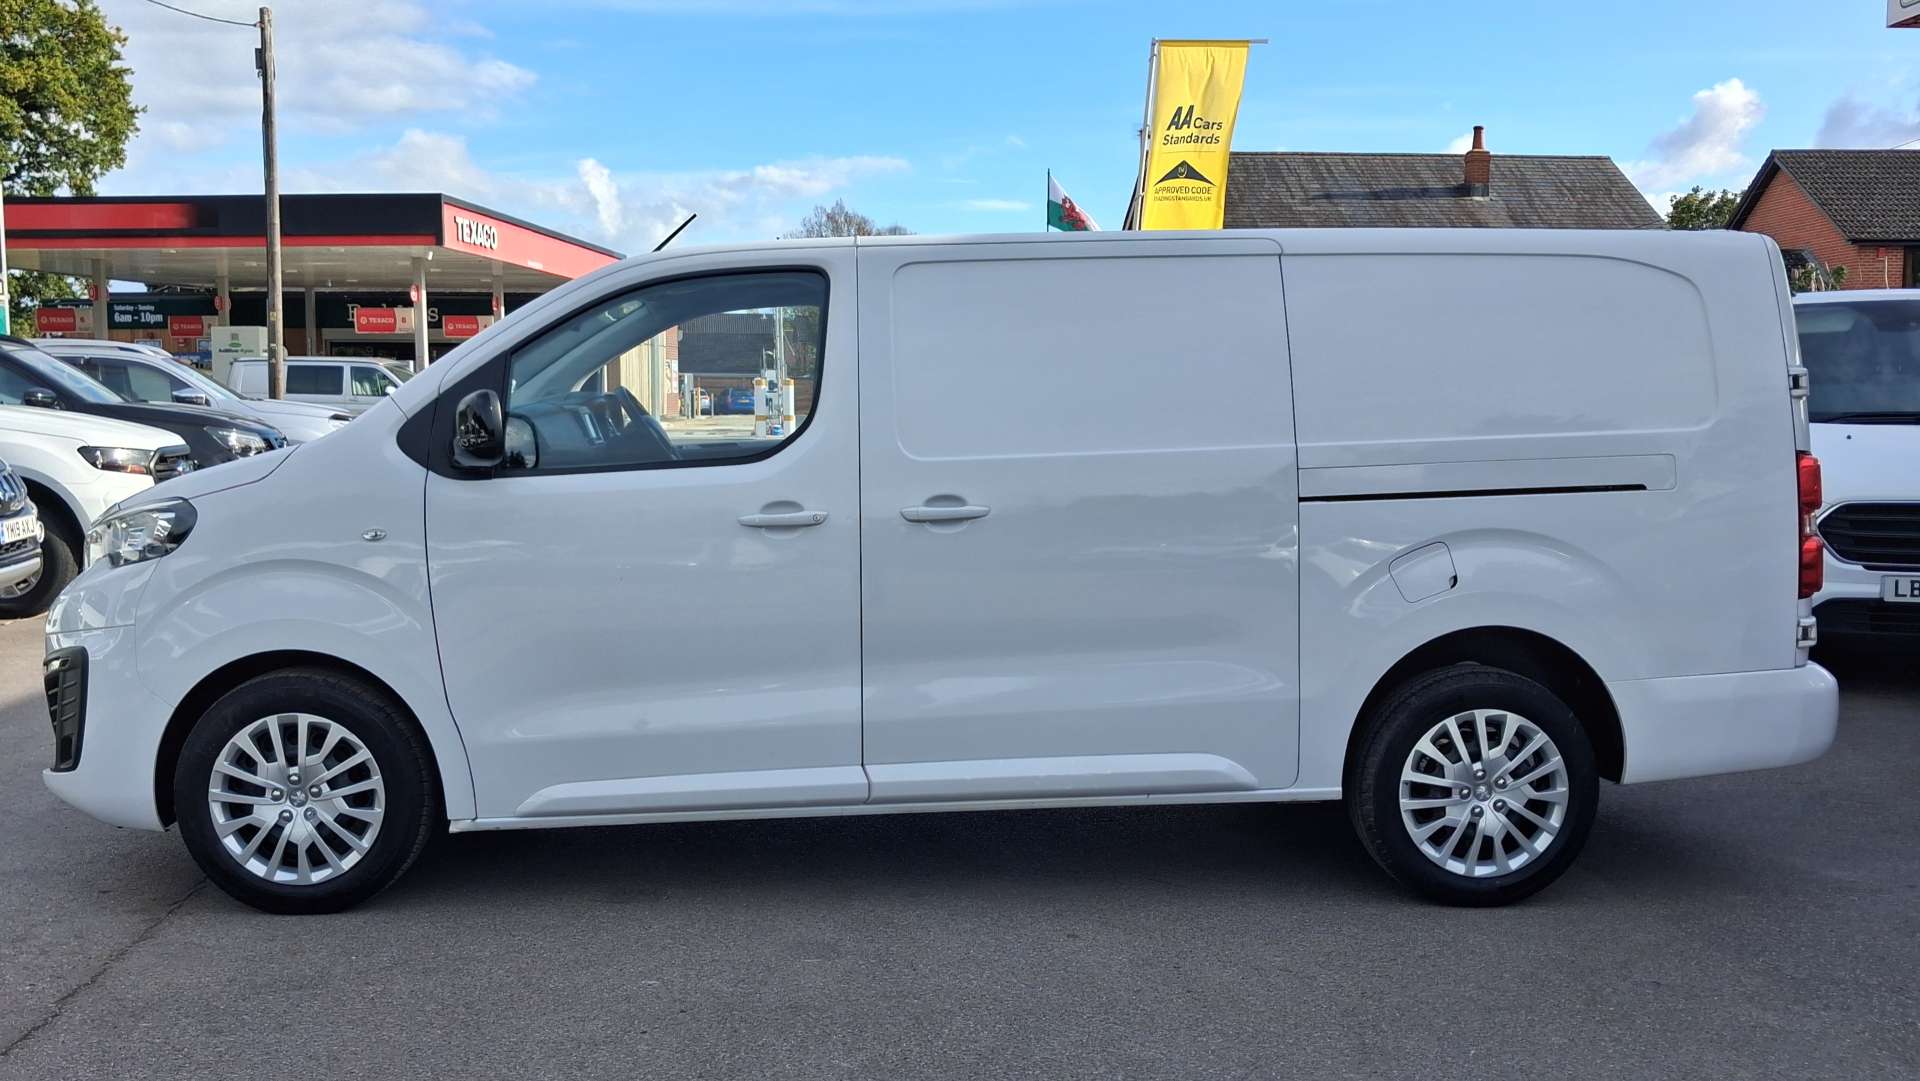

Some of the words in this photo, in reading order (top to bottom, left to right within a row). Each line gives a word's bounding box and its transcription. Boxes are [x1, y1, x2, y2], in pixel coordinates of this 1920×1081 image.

[1166, 104, 1194, 131] AA
[1193, 117, 1222, 130] Cars
[1162, 133, 1220, 145] Standards
[1154, 185, 1190, 195] APPROVED
[1191, 186, 1212, 195] CODE
[454, 216, 497, 250] TEXACO
[114, 312, 133, 322] 6am
[140, 312, 163, 324] 10pm
